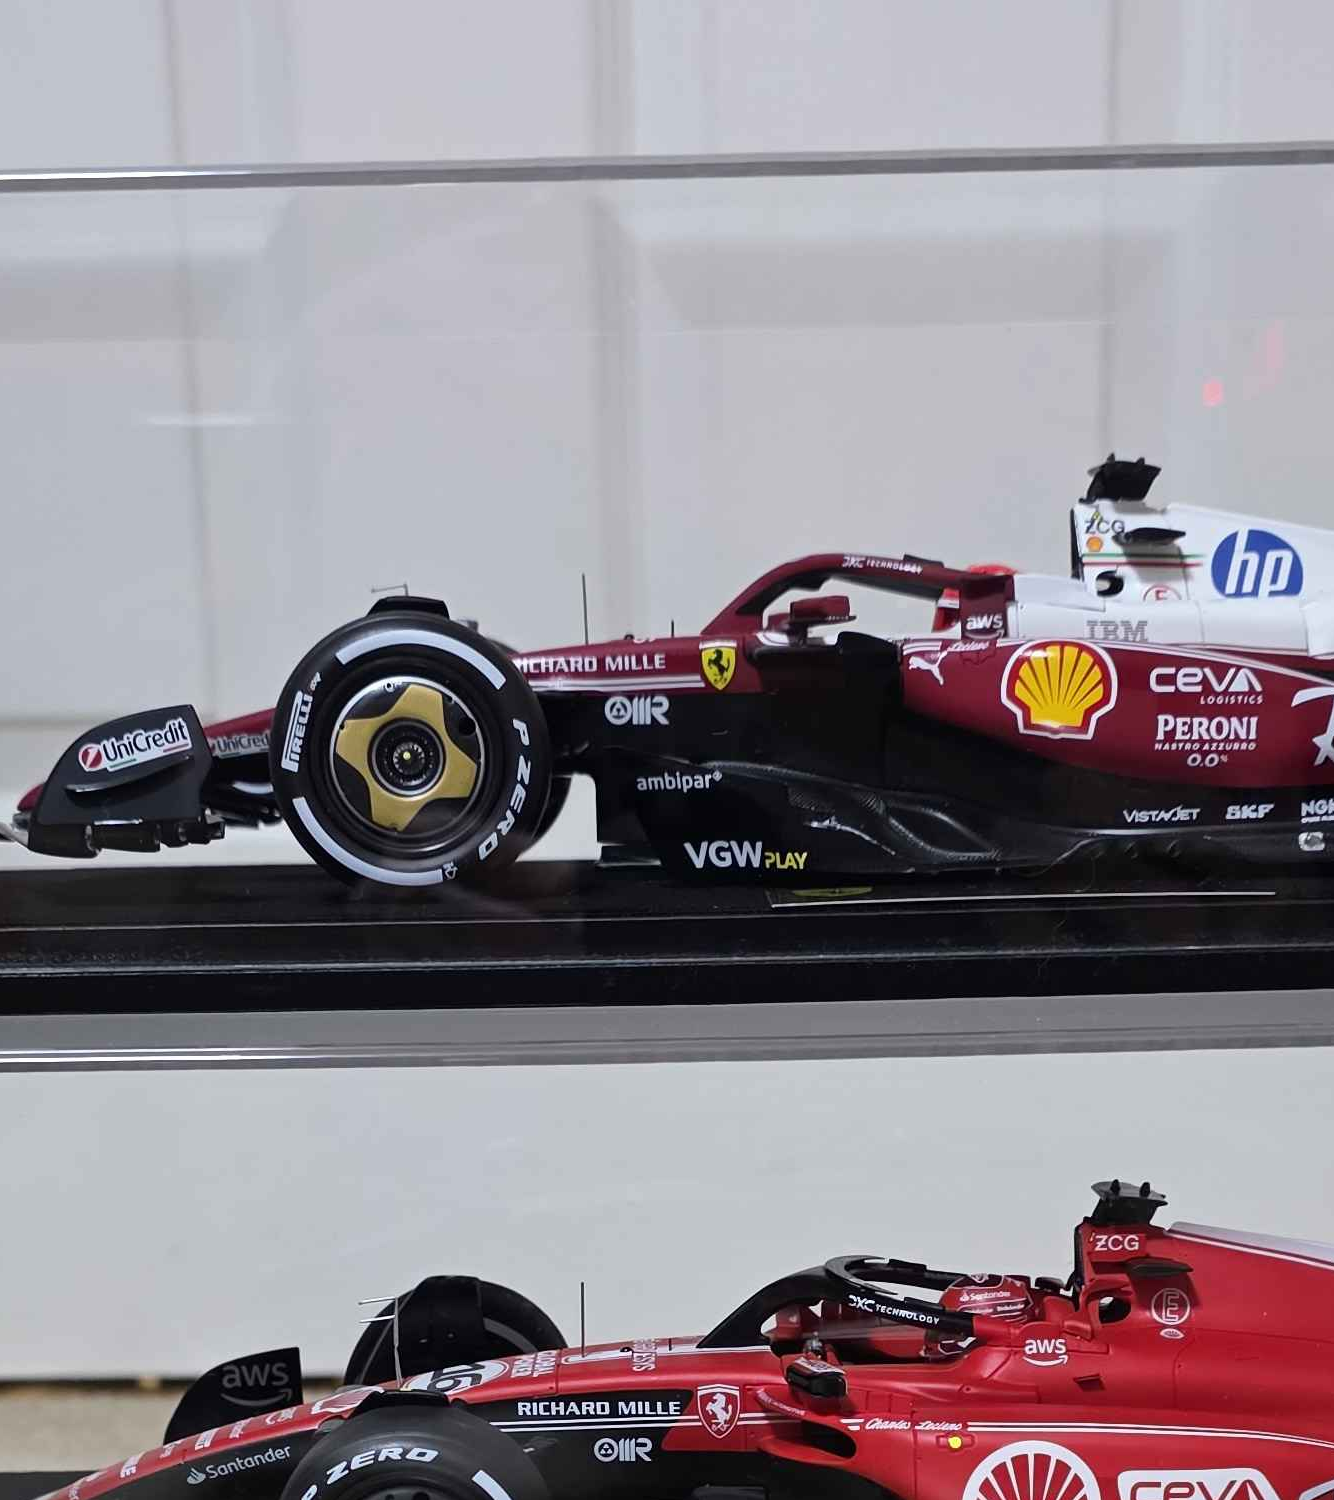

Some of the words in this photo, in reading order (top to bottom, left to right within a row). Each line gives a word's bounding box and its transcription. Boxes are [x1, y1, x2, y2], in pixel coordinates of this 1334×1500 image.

[1225, 529, 1292, 598] hp
[966, 613, 1004, 631] aws
[1086, 620, 1148, 642] IBM
[605, 652, 667, 673] MILLE
[1199, 694, 1264, 705] LOGISTICS
[101, 717, 188, 761] UniCredit
[1156, 715, 1259, 742] PERONI
[636, 771, 713, 794] ambipar
[478, 744, 536, 862] ZERO
[1225, 803, 1275, 820] SKF
[1123, 806, 1201, 824] VISTAJET
[683, 839, 764, 869] VGW
[764, 850, 809, 872] PLAY
[1094, 1234, 1141, 1253] ZCG
[875, 1303, 941, 1326] TECHNOLOGY
[1024, 1337, 1067, 1355] aws
[221, 1361, 290, 1390] aws
[517, 1400, 611, 1417] RICHARD
[617, 1399, 681, 1416] MILLE
[205, 1443, 292, 1481] Santander
[325, 1445, 440, 1487] ZERO
